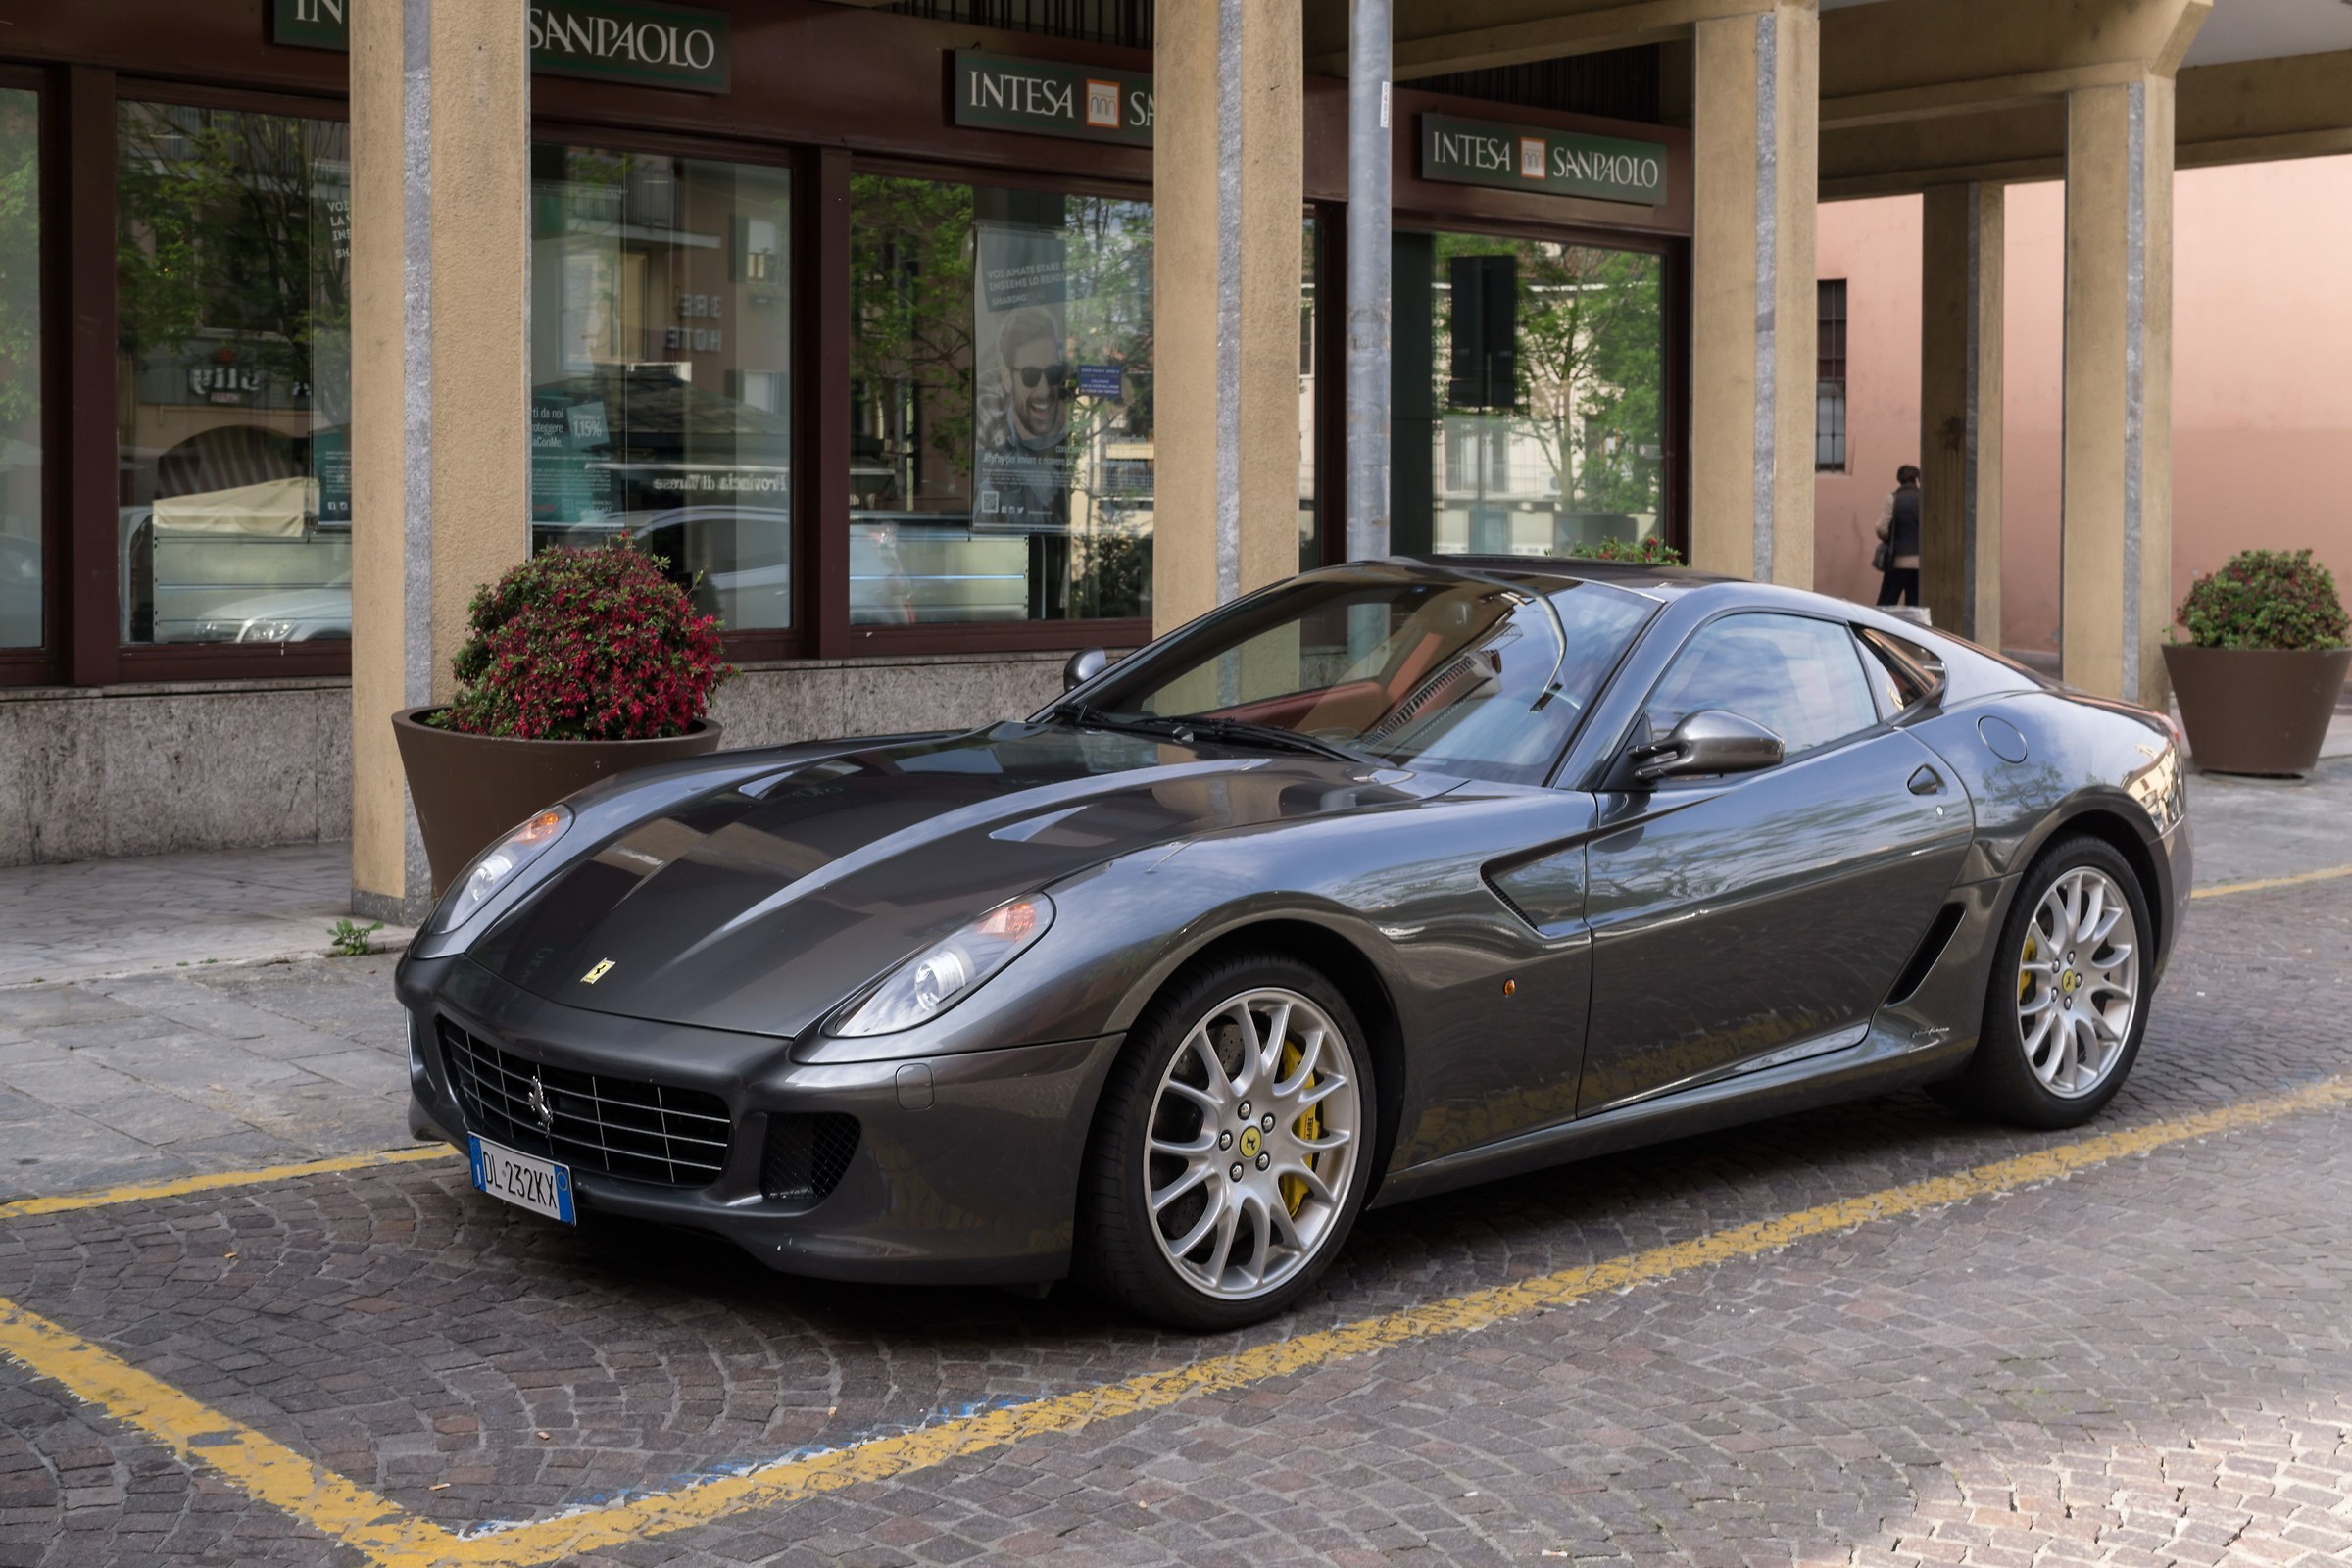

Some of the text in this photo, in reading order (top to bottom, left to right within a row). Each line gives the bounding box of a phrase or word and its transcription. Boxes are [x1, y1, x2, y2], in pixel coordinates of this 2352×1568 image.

[530, 8, 715, 70] SANPAOLO
[969, 71, 1074, 119] INTESA
[1433, 131, 1659, 188] INTESA SANPAOLO
[989, 277, 1027, 292] INSIEME
[1006, 265, 1035, 277] AMATE
[483, 1151, 558, 1209] DL 232KX
